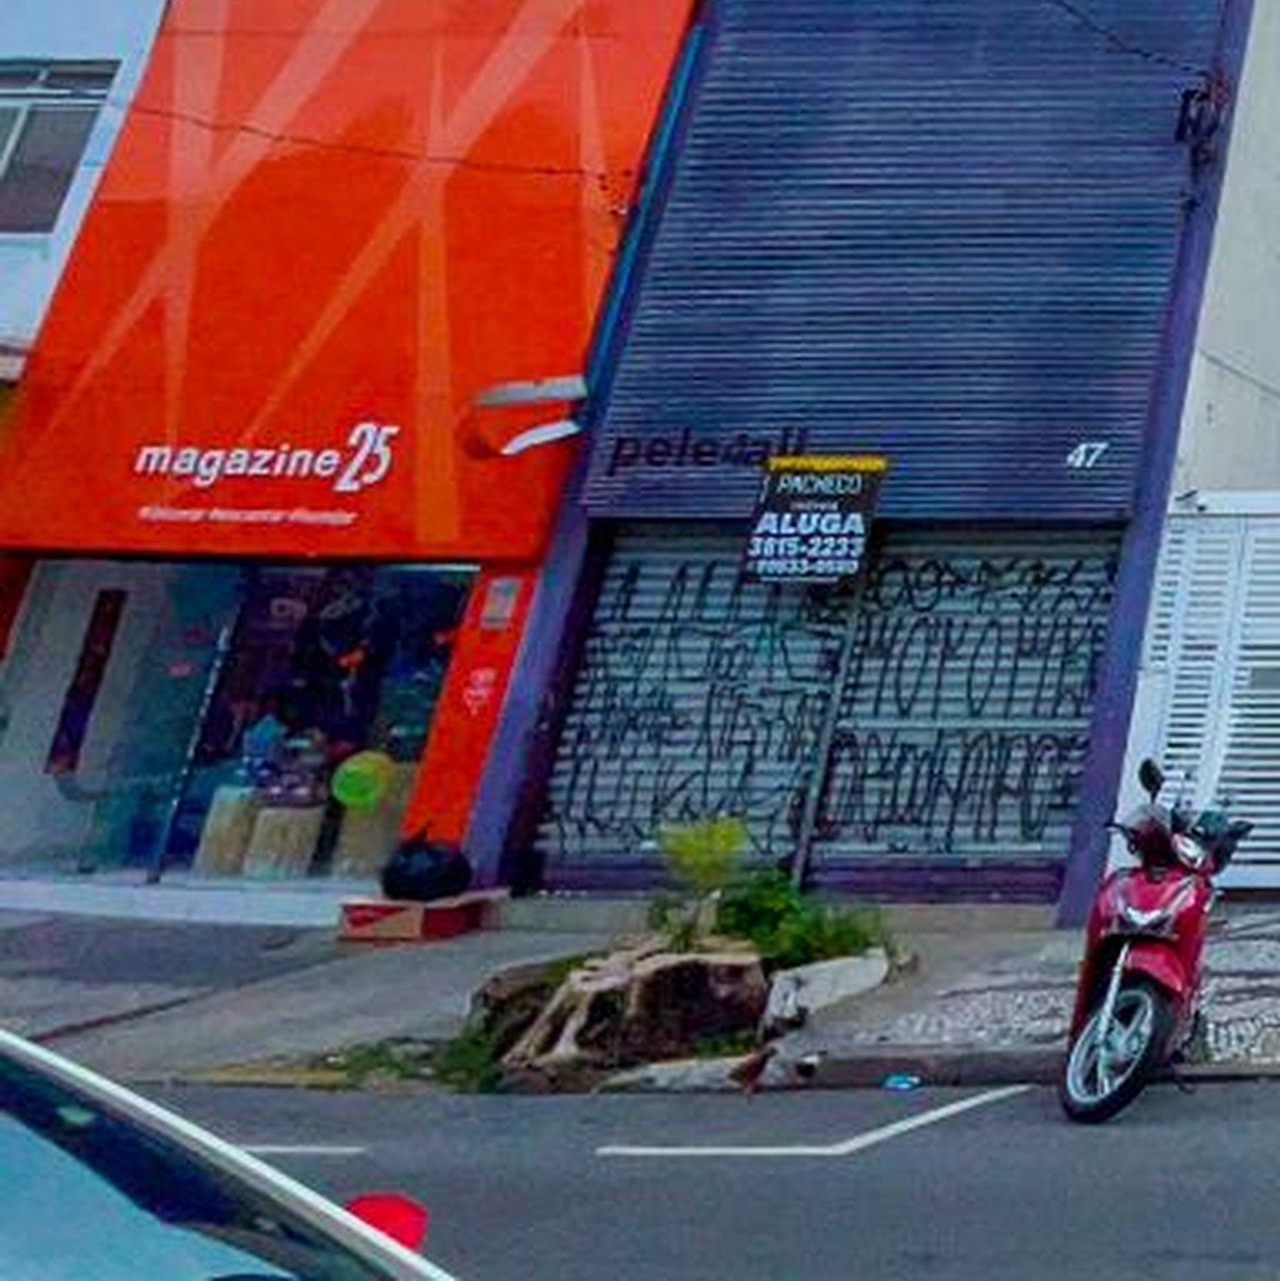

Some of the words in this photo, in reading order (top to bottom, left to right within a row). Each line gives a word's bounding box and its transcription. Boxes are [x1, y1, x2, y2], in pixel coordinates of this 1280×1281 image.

[134, 433, 341, 487] magazine
[332, 421, 400, 492] 25
[1066, 442, 1108, 468] 47
[776, 473, 863, 494] PACHECO
[755, 512, 865, 535] ALUGA
